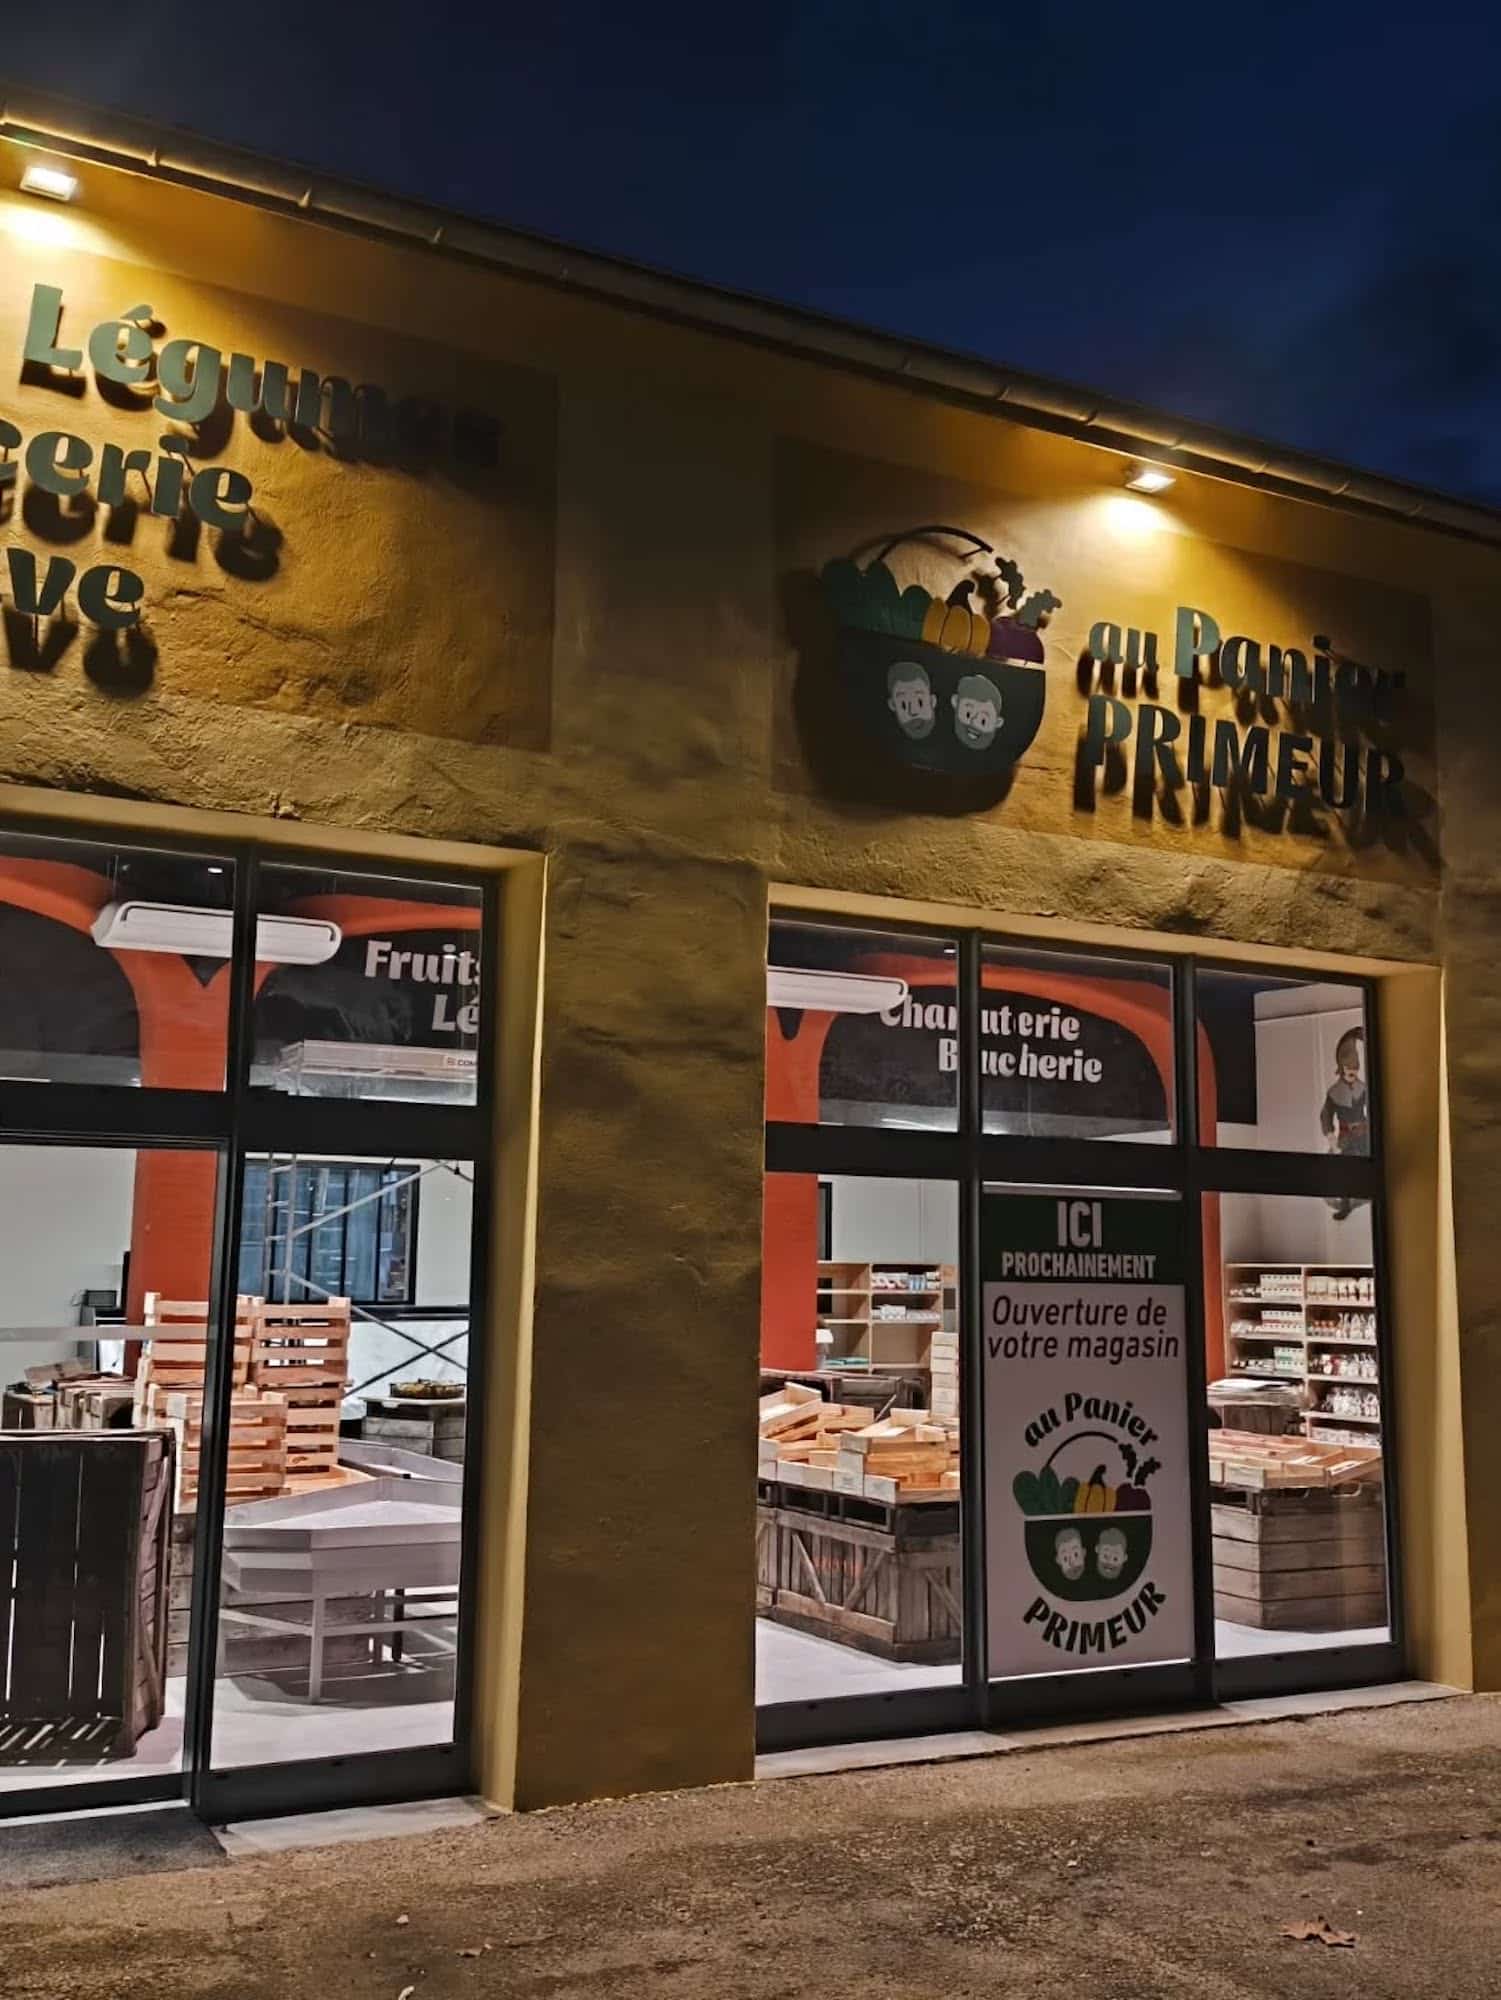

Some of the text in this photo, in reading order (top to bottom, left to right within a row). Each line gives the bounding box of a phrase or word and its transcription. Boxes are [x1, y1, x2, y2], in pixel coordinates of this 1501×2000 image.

[1089, 620, 1159, 672] au
[1086, 693, 1408, 814] PRIMEUR
[939, 1037, 1103, 1084] Bucherie
[1057, 1200, 1102, 1248] ICI
[1001, 1251, 1157, 1279] PROCHAINEMENT
[992, 1295, 1168, 1327] Ouverture de
[987, 1329, 1180, 1365] votre magasin
[1024, 1392, 1159, 1447] au Panier
[1023, 1581, 1167, 1655] PRIMEUR
